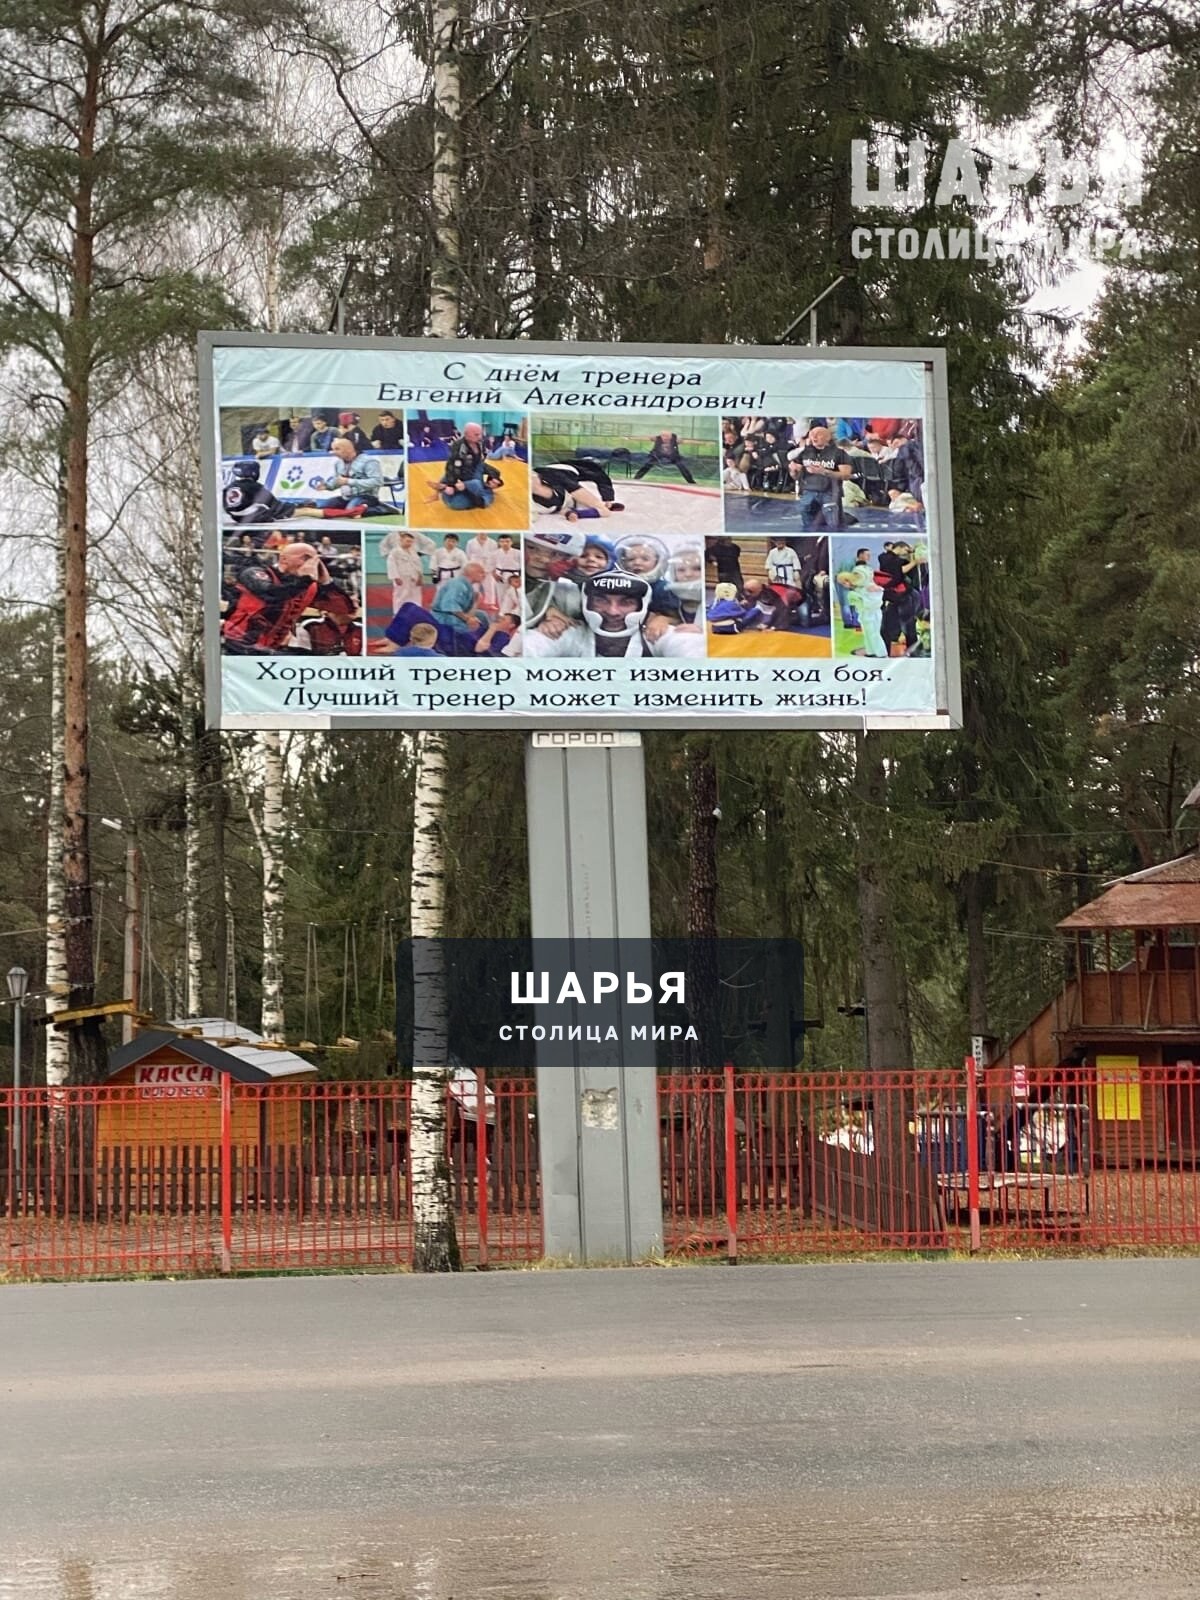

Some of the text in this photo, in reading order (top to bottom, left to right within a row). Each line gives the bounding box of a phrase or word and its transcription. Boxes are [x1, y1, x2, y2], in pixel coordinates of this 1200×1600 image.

[443, 362, 702, 390] С днём тренера
[376, 382, 767, 413] Евгений Александрович!
[593, 578, 632, 589] VENUM
[256, 661, 892, 686] Хороший тренер может изменить ход боя.
[283, 686, 867, 711] Лучший тренер может изменить жизнь!
[537, 732, 615, 745] ГОРОД
[139, 1065, 213, 1082] КАССА
